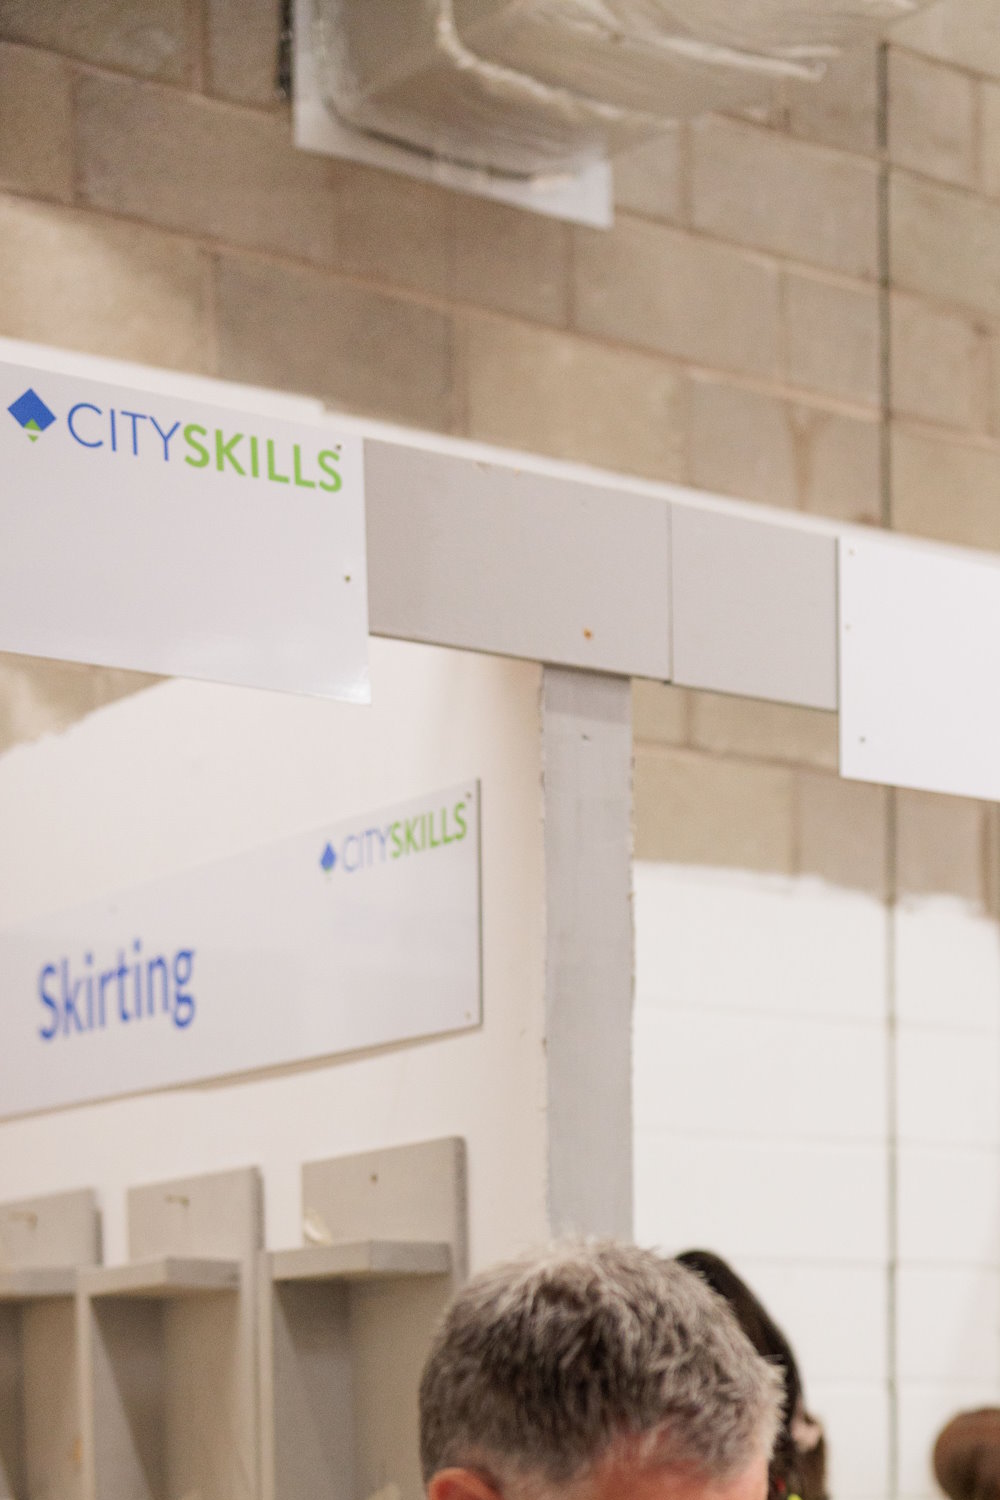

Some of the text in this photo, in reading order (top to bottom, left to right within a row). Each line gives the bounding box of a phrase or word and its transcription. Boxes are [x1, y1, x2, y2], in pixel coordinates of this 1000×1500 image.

[67, 402, 344, 493] CITYSKILLS
[342, 801, 468, 875] CITYSKILLS
[37, 937, 197, 1043] Skirting
